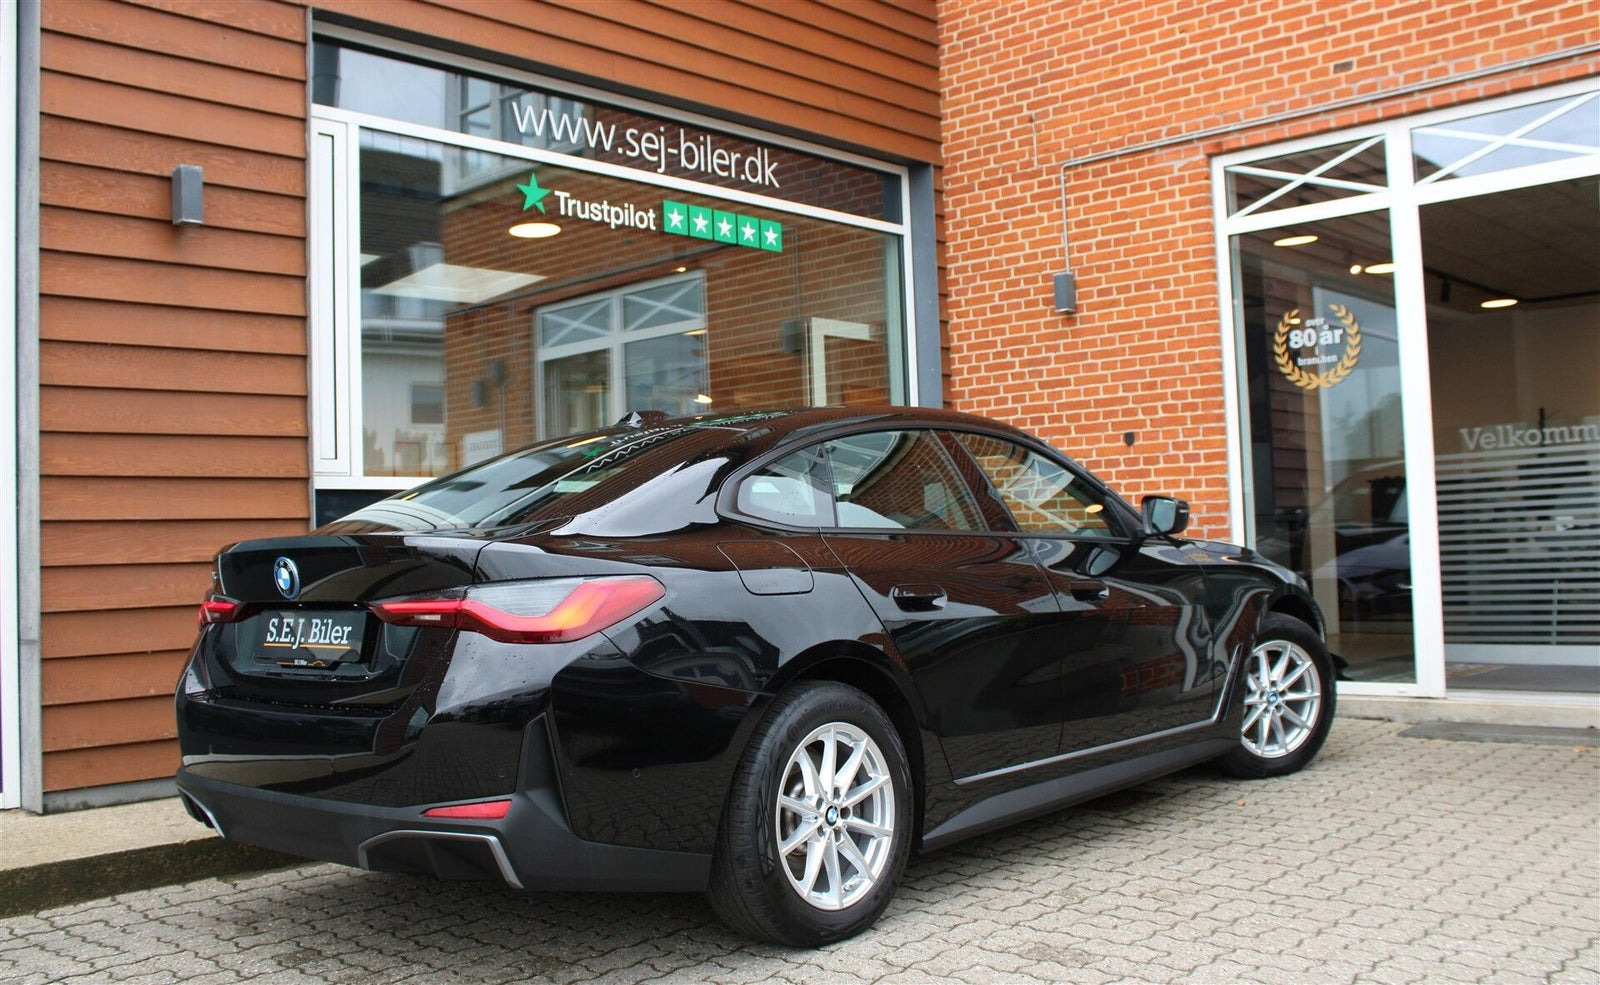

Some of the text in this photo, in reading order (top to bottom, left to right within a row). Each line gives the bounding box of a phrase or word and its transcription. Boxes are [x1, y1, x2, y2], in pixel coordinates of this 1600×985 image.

[511, 101, 780, 188] www.sej-biler.dk
[554, 190, 656, 231] Trustpilot
[1289, 324, 1343, 349] 80 år
[1305, 318, 1325, 327] over
[1298, 355, 1337, 366] branchen
[266, 617, 352, 649] S.E.J. Biler
